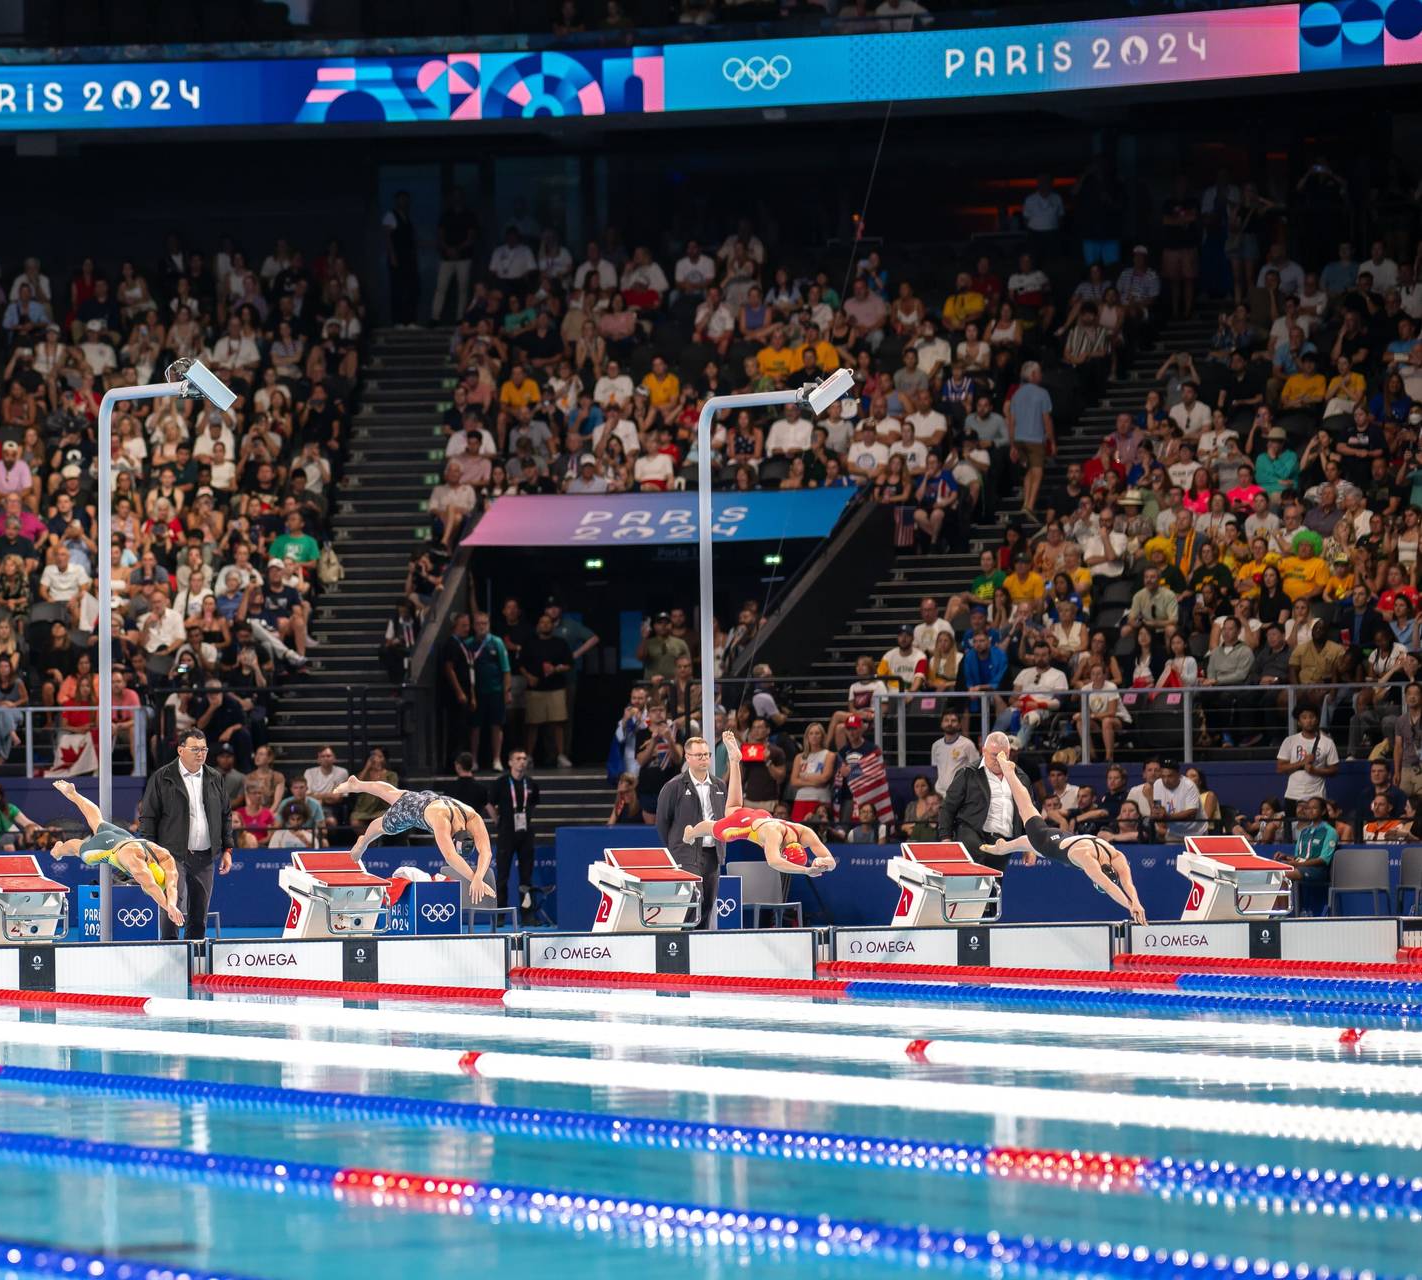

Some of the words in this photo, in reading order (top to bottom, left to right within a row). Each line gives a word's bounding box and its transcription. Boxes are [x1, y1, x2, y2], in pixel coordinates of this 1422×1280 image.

[1092, 32, 1206, 69] 2024
[83, 79, 200, 111] 2024
[580, 506, 749, 526] PARS
[1192, 888, 1200, 907] 0
[291, 906, 298, 925] 3
[601, 900, 609, 919] 2
[646, 906, 661, 924] 2
[84, 923, 101, 936] 202
[866, 941, 915, 952] OMEGA
[1161, 935, 1209, 946] OMEGA
[244, 954, 297, 966] OMEGA
[560, 947, 611, 959] OMEGA
